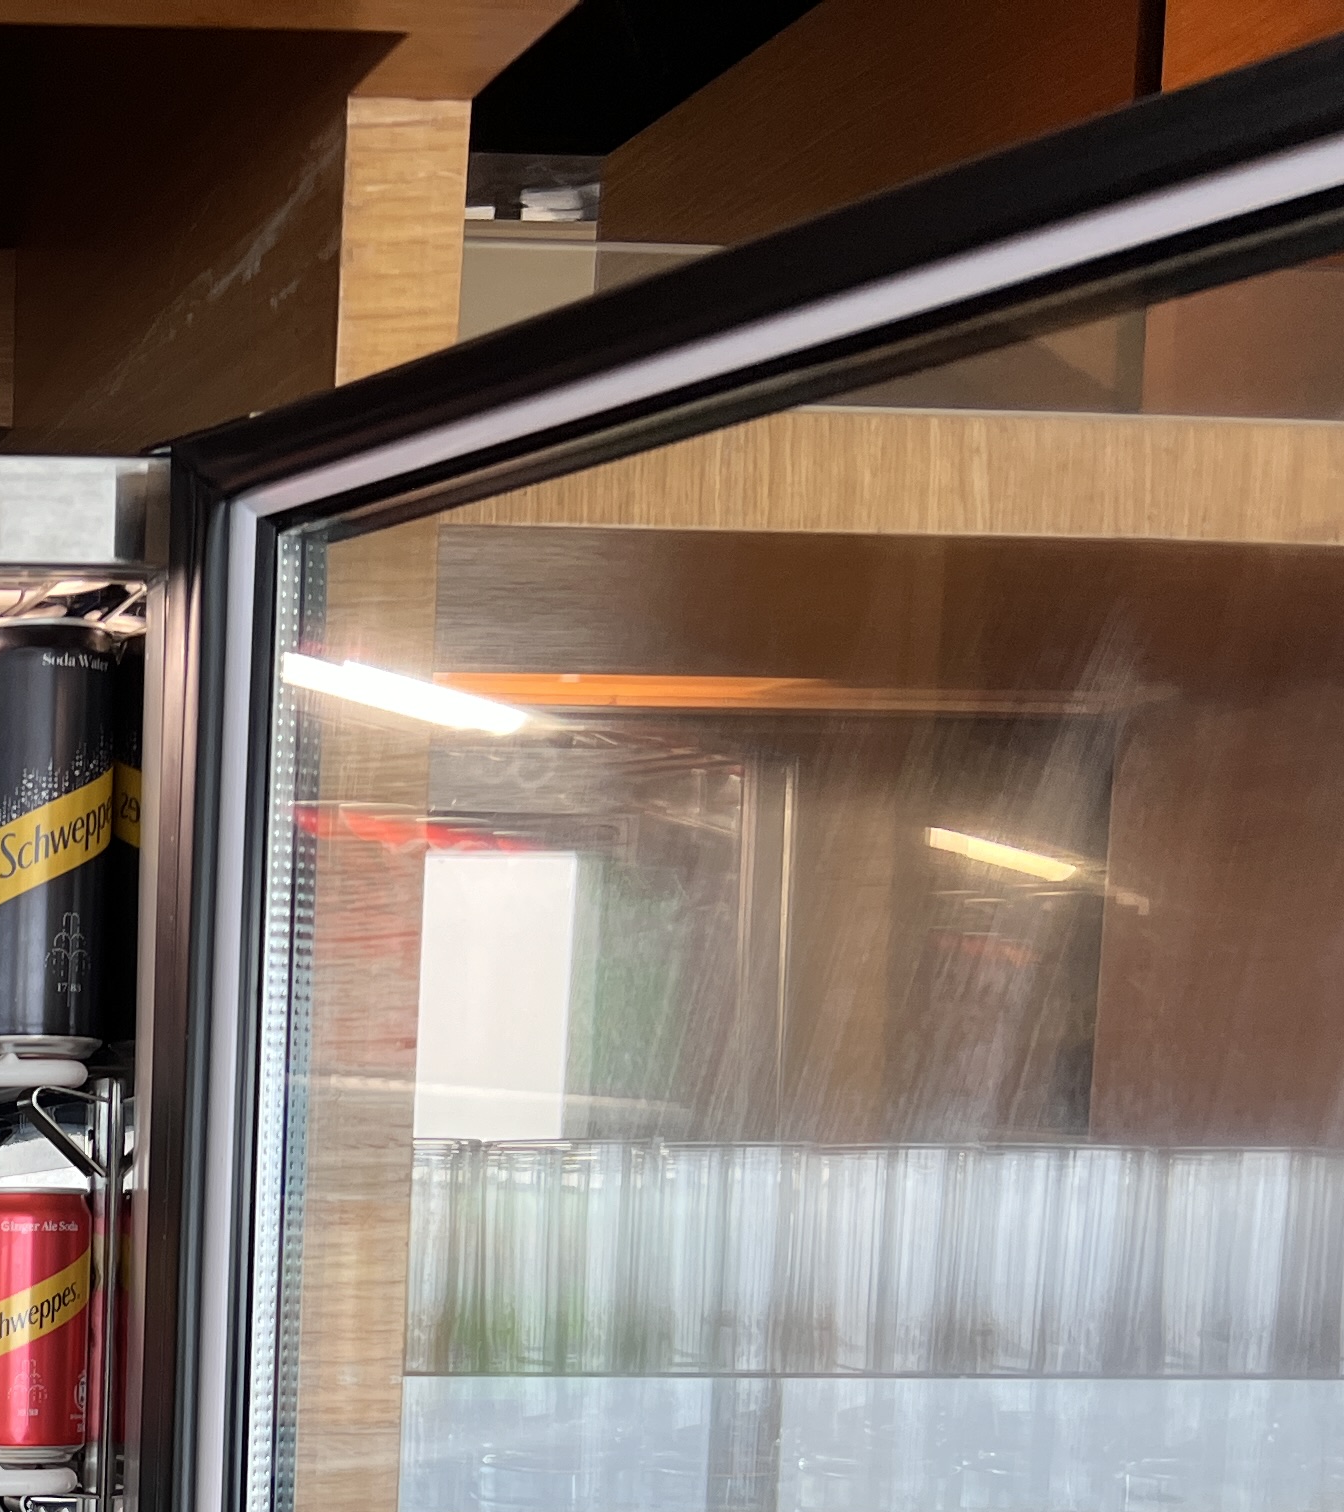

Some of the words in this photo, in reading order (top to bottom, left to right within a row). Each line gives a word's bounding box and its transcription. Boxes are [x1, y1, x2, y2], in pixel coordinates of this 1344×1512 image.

[41, 652, 76, 667] Soda
[0, 1221, 41, 1235] Ginger
[42, 1221, 58, 1232] Ale
